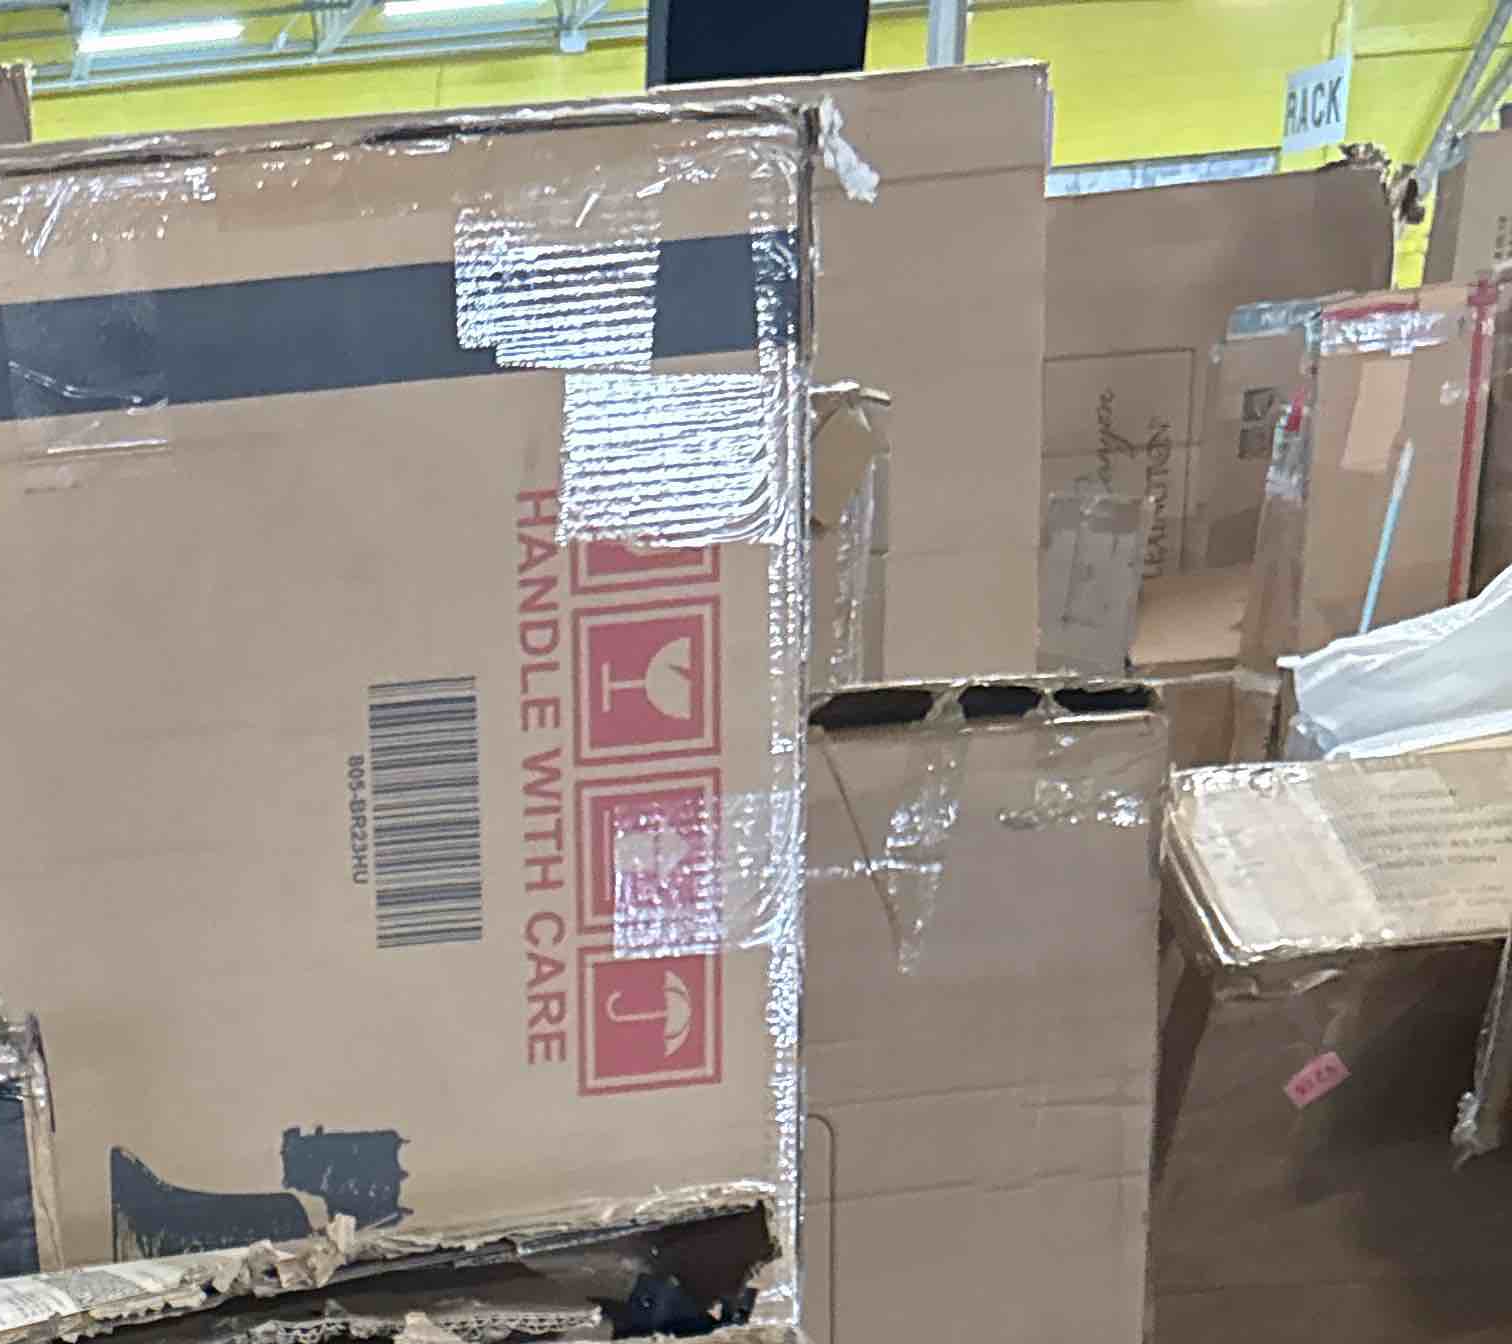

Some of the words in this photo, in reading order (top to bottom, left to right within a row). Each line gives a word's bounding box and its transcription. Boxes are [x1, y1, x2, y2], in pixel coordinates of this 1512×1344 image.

[1284, 75, 1344, 136] RACK
[515, 487, 560, 733] HANDLE
[521, 750, 566, 896] WITH
[523, 914, 568, 1066] CARE
